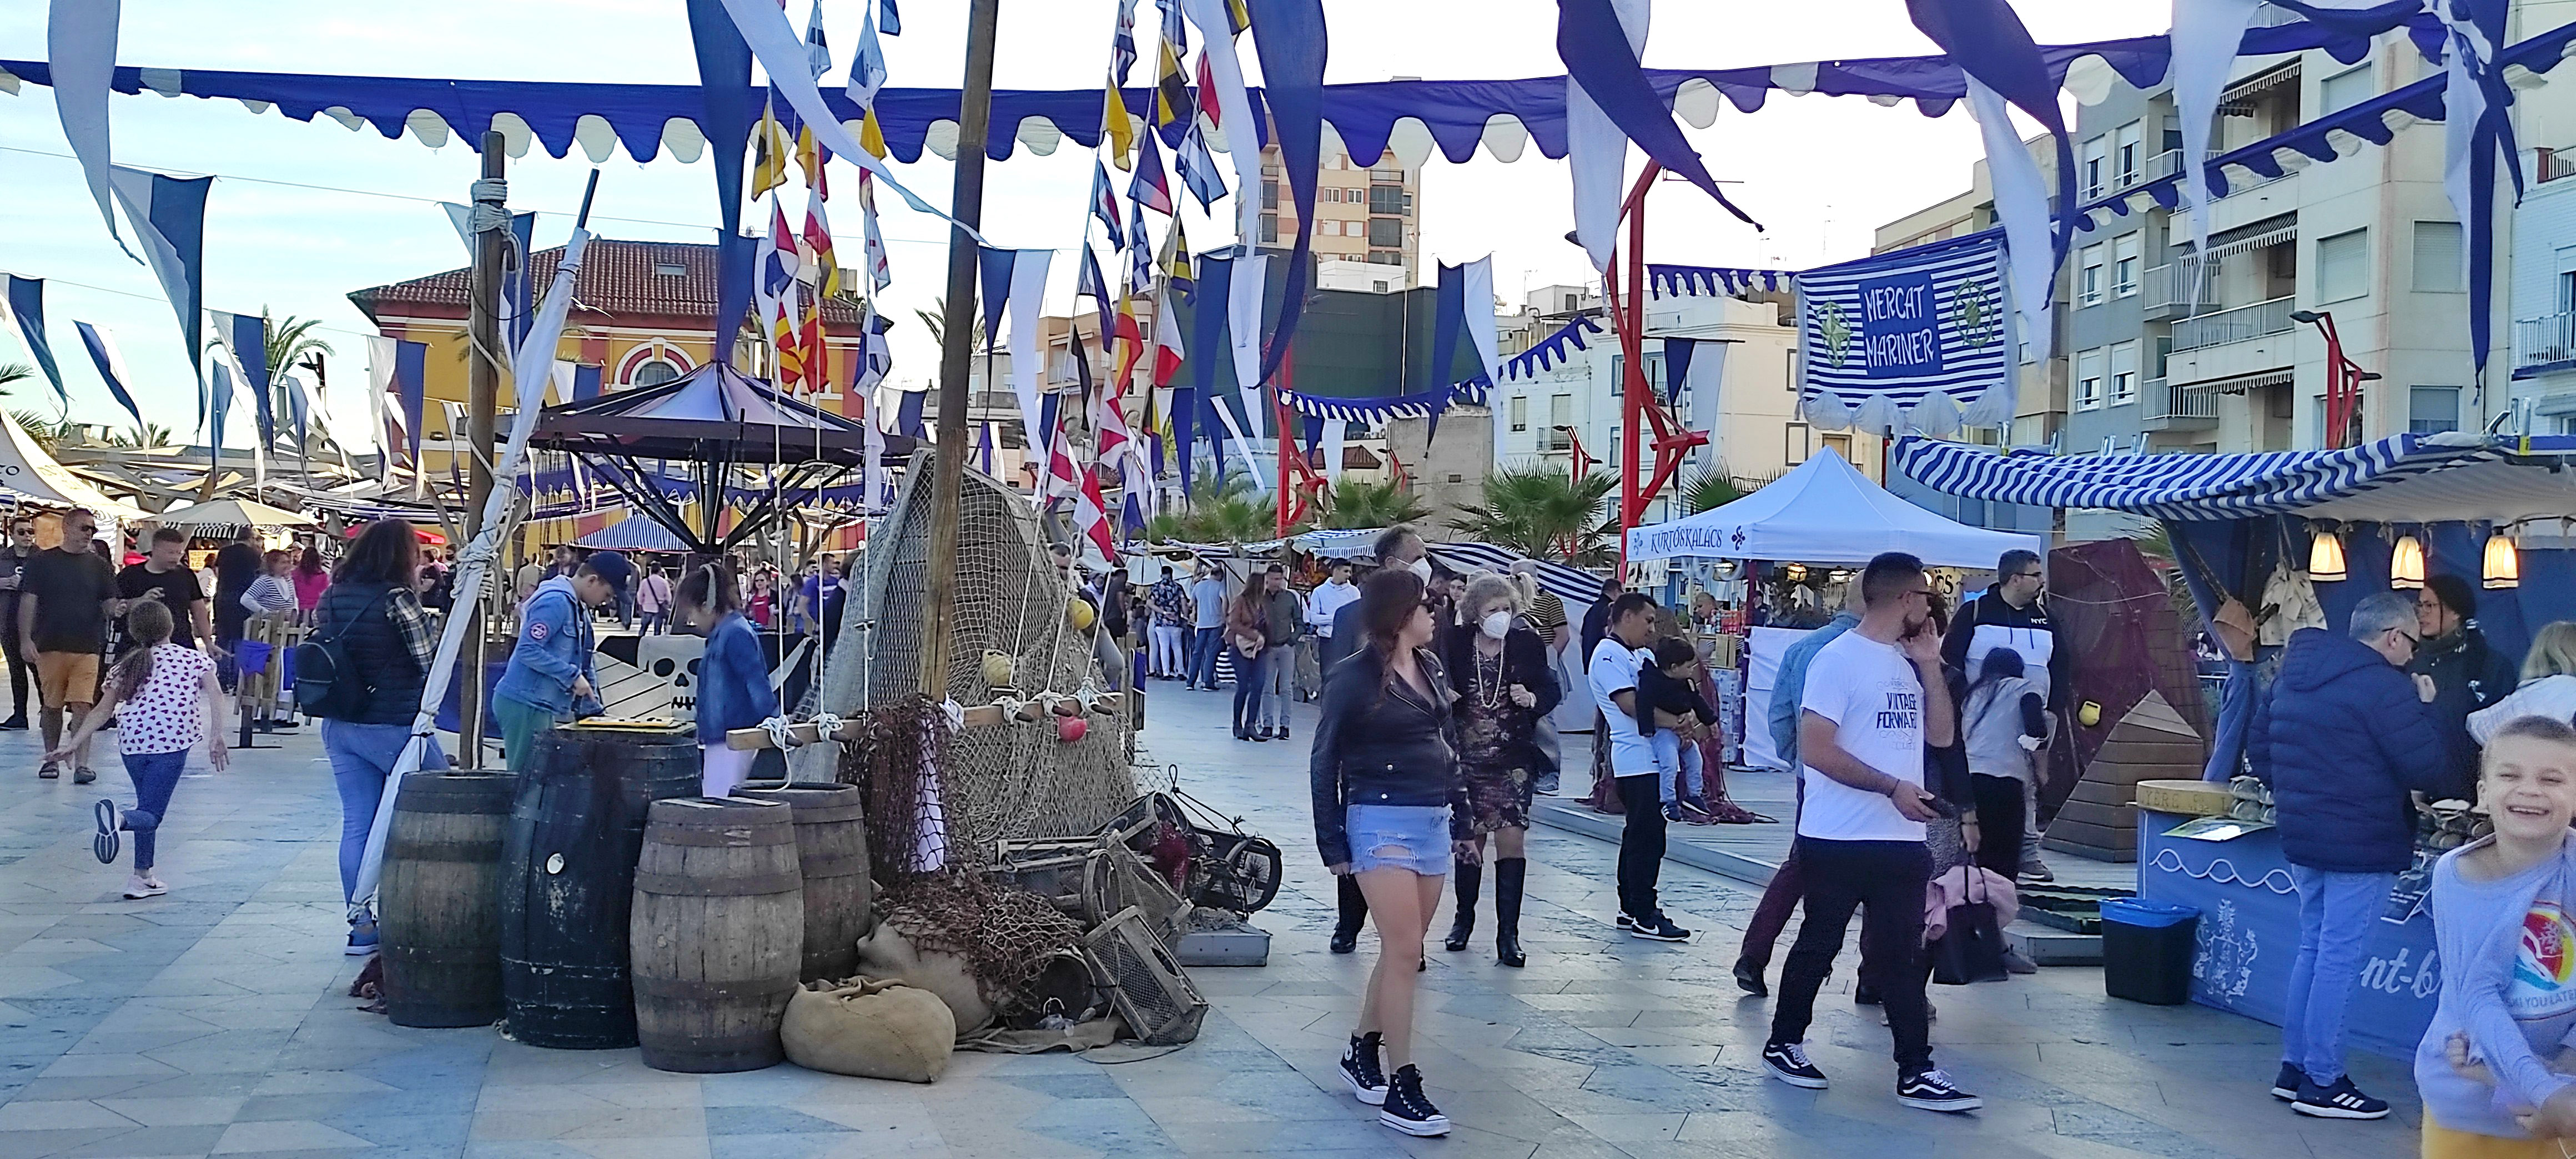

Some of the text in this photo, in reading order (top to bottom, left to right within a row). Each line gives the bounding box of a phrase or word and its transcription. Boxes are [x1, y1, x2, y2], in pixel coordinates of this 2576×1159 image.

[1864, 284, 1925, 322] MERCAT
[1865, 328, 1934, 368] MARINER
[2360, 948, 2442, 999] nt-b
[2525, 996, 2547, 1008] YOU
